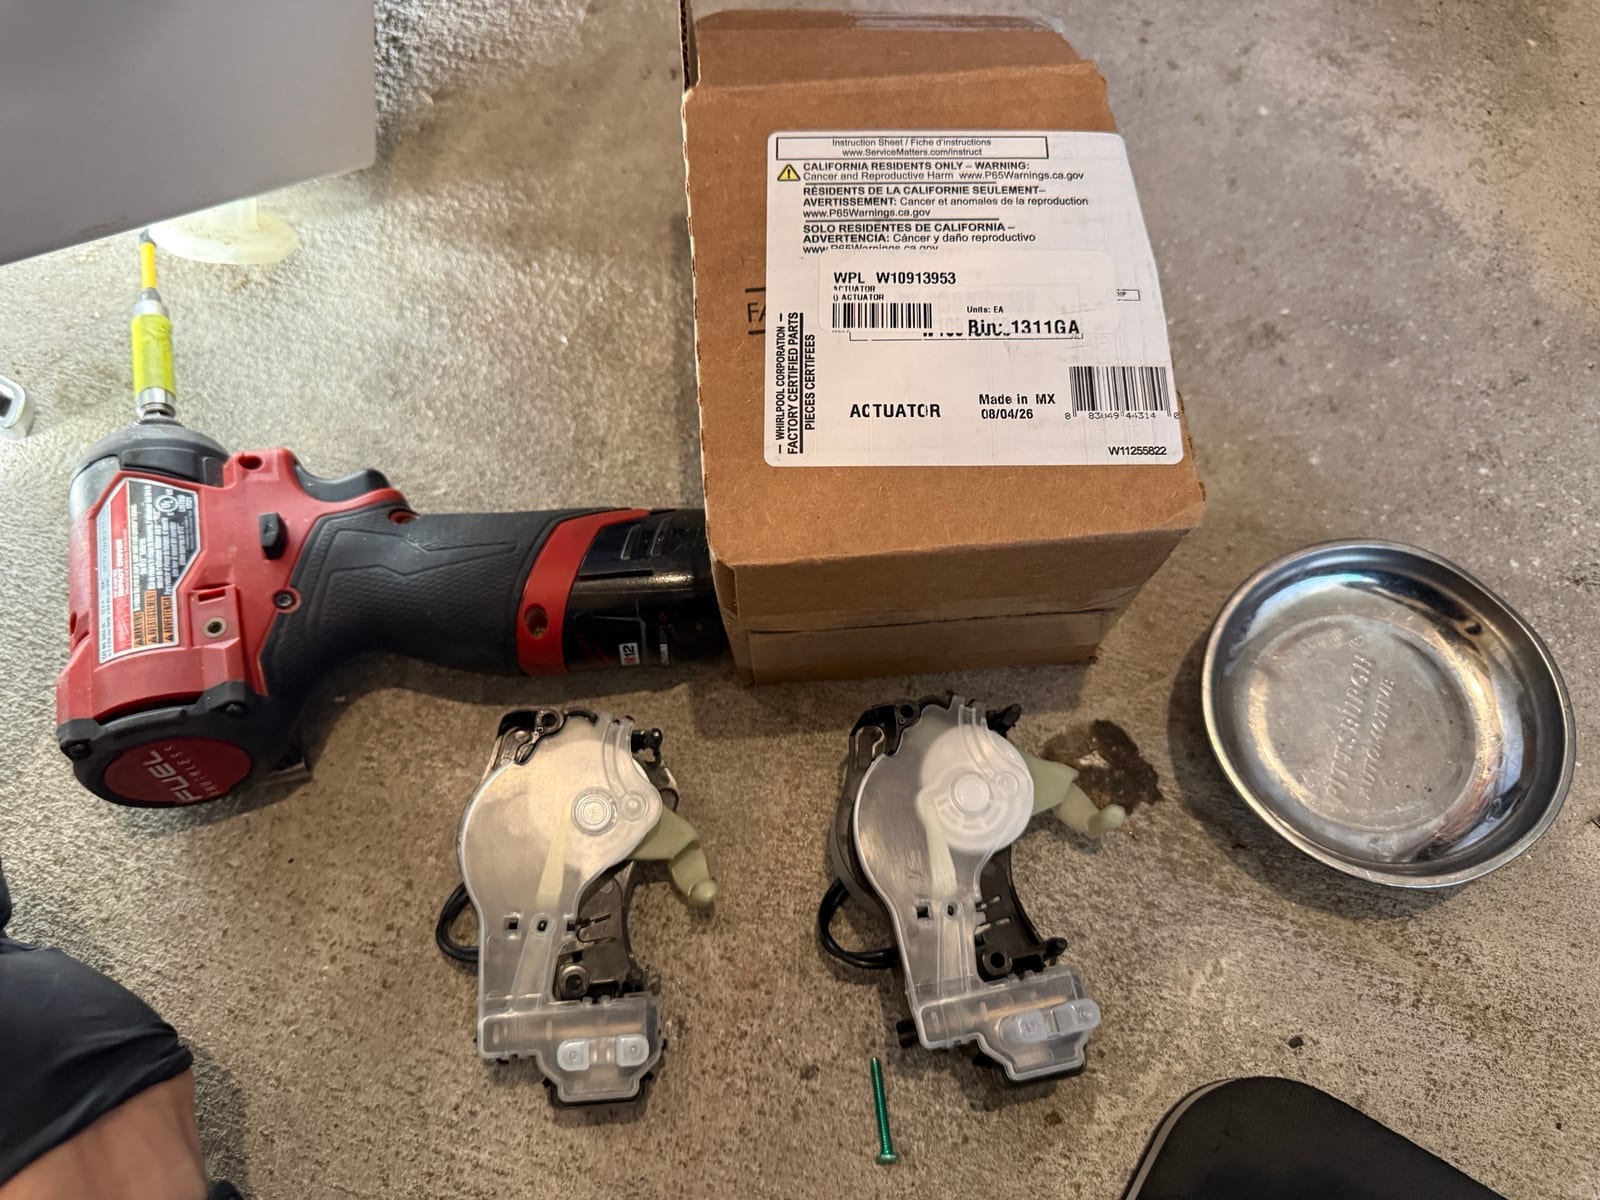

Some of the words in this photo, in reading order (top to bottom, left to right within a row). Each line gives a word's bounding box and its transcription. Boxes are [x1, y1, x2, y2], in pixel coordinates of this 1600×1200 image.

[832, 138, 876, 147] Instruction
[878, 138, 903, 146] Sheet
[910, 138, 934, 146] Fiche
[936, 138, 991, 146] d'instructions
[842, 148, 982, 157] www.ServiceMatters.com/instruct
[803, 162, 868, 171] CALIFORNIA
[871, 162, 932, 171] RESIDENTS
[934, 161, 963, 170] ONLY
[975, 161, 1029, 170] WARNING:
[803, 172, 837, 181] Cancer
[840, 171, 859, 180] and
[861, 171, 924, 182] Reproductive
[927, 171, 954, 180] Harm
[959, 171, 1084, 181] www.P65Warnings.ca.gov
[803, 185, 865, 196] RÉSIDENTS
[868, 186, 883, 195] DE
[886, 186, 900, 195] LA
[903, 185, 970, 195] CALIFORNIE
[803, 197, 897, 207] AVERTISSEMENT:
[900, 197, 935, 206] Cancer
[938, 197, 947, 206] et
[950, 197, 998, 206] anomales
[1000, 197, 1013, 206] de
[1015, 197, 1025, 206] la
[1028, 196, 1089, 207] reproduction
[803, 207, 931, 219] www.P65Warnings.ca.gov
[803, 224, 836, 234] SOLO
[838, 223, 912, 233] RESIDENTES
[915, 223, 931, 232] DE
[934, 222, 1006, 232] CALIFORNIA
[803, 233, 889, 244] ADVERTENCIA:
[892, 233, 931, 243] Cáncer
[933, 234, 940, 245] y
[942, 232, 969, 243] daño
[971, 232, 1036, 244] reproductivo
[833, 271, 865, 284] WPL
[876, 271, 956, 285] W10913953
[841, 293, 885, 301] ACTUATOR
[966, 305, 991, 314] Units:
[993, 305, 1004, 314] EA
[787, 311, 799, 345] PARTS
[1011, 319, 1080, 334] 1311GA
[775, 326, 786, 387] CORPORATION
[804, 334, 816, 390] CERTIFEES
[787, 347, 798, 402] CERTIFIED
[979, 393, 1013, 405] Made
[1016, 393, 1028, 405] in
[1035, 393, 1056, 405] MX
[775, 388, 785, 441] WHIRLPOOL
[804, 392, 816, 430] PIECES
[849, 403, 941, 418] ACTUATOR
[981, 408, 1034, 420] 08/04/26
[1064, 412, 1071, 420] 8
[787, 404, 798, 455] FACTORY
[1108, 446, 1168, 456] W11255822
[142, 750, 203, 801] FUEL
